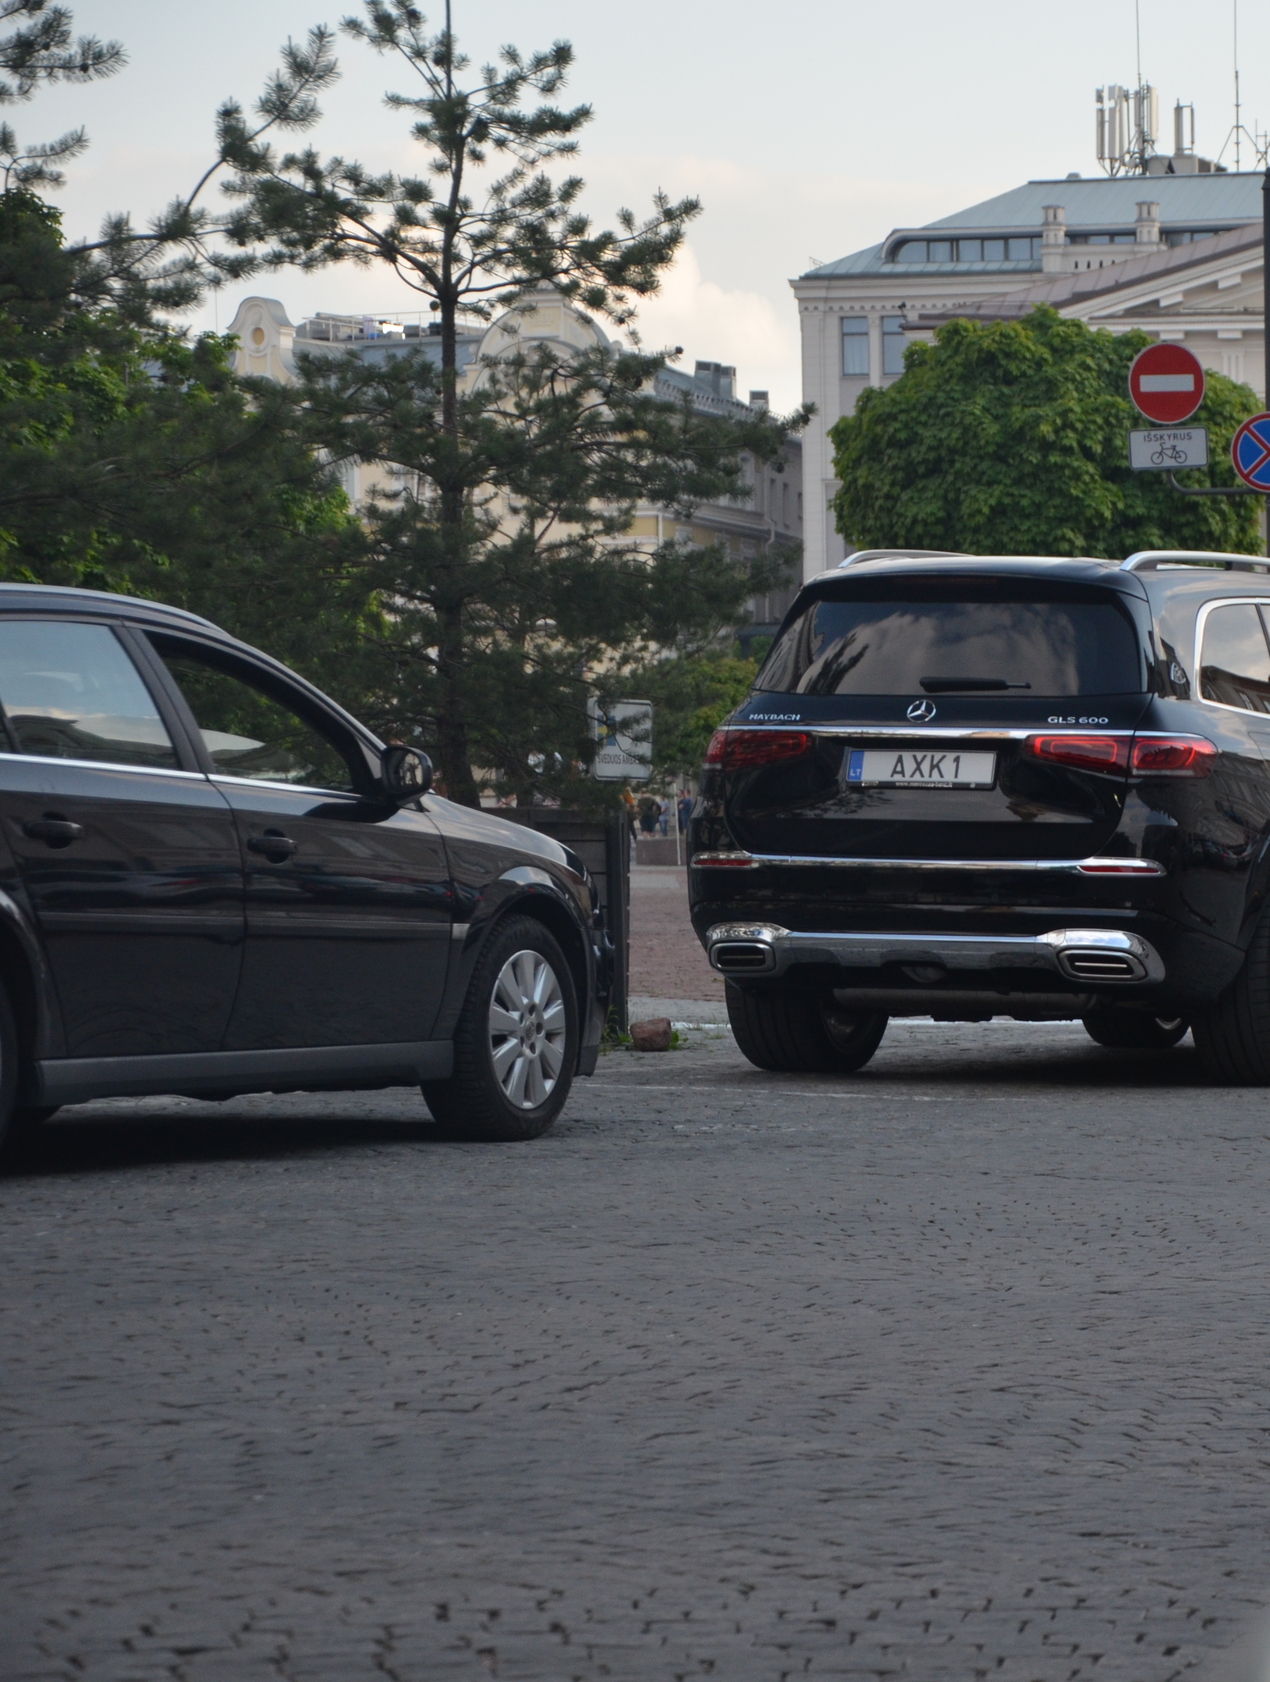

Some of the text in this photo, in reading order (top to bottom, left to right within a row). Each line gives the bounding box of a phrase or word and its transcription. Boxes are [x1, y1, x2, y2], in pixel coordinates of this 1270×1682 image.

[1143, 431, 1192, 442] IŠSKYRUS
[748, 713, 801, 721] MAYBACH
[1047, 715, 1109, 724] GLS 600
[890, 754, 961, 779] AXK1
[849, 768, 862, 777] LT
